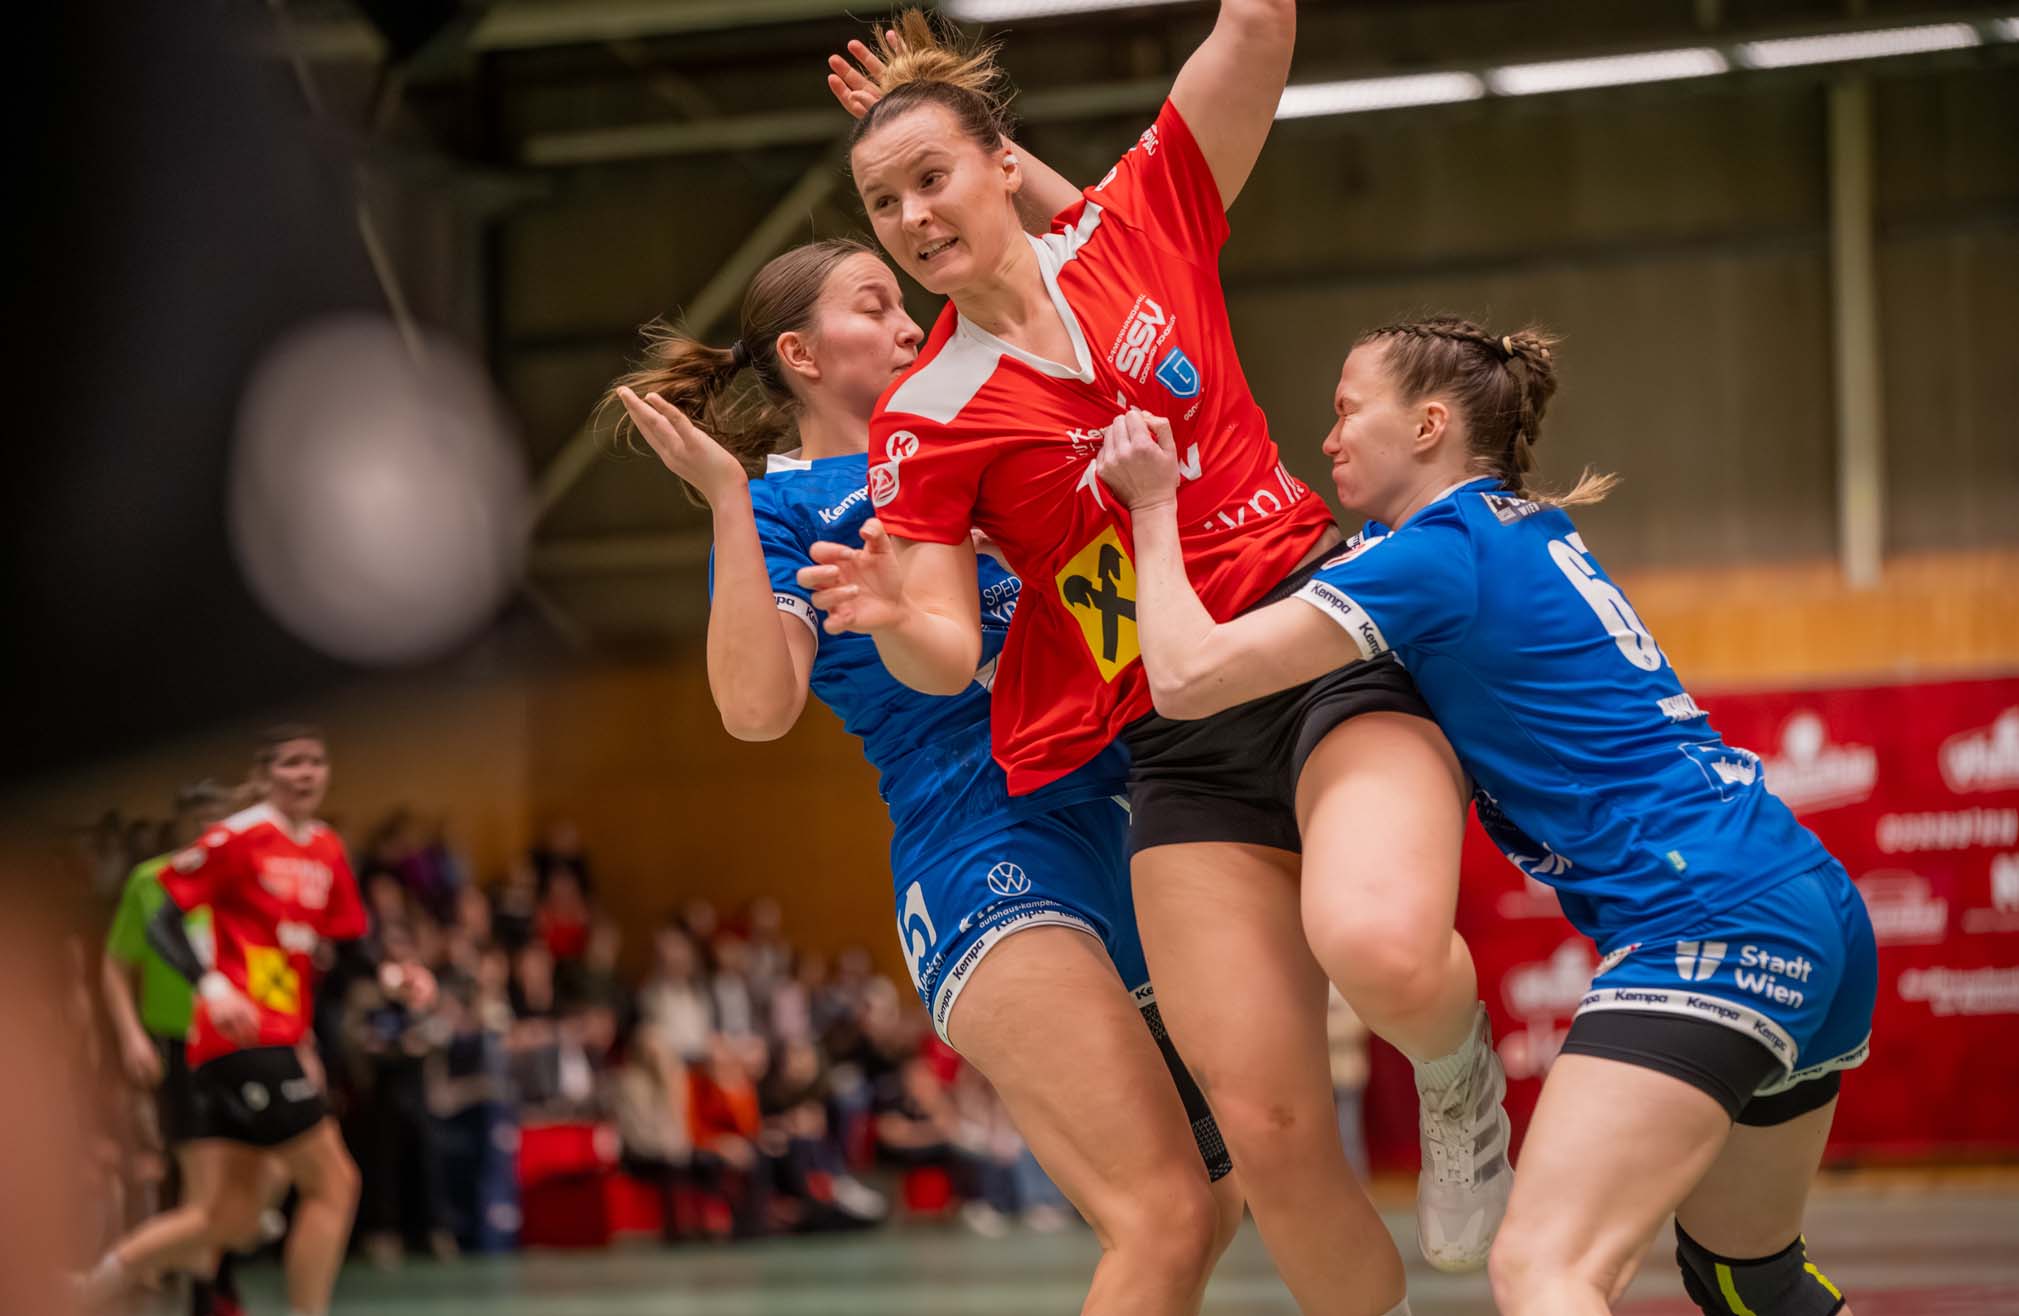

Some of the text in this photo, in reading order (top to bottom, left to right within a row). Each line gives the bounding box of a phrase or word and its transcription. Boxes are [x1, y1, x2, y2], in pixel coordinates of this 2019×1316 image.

[1115, 298, 1166, 379] SSV
[818, 485, 869, 524] Kemp
[1311, 582, 1352, 614] Kempa
[952, 939, 985, 981] Kempa
[1738, 945, 1813, 982] Stadt
[1615, 991, 1669, 1005] Kempa
[1687, 997, 1740, 1020] Kempa
[1734, 968, 1804, 1008] Wien
